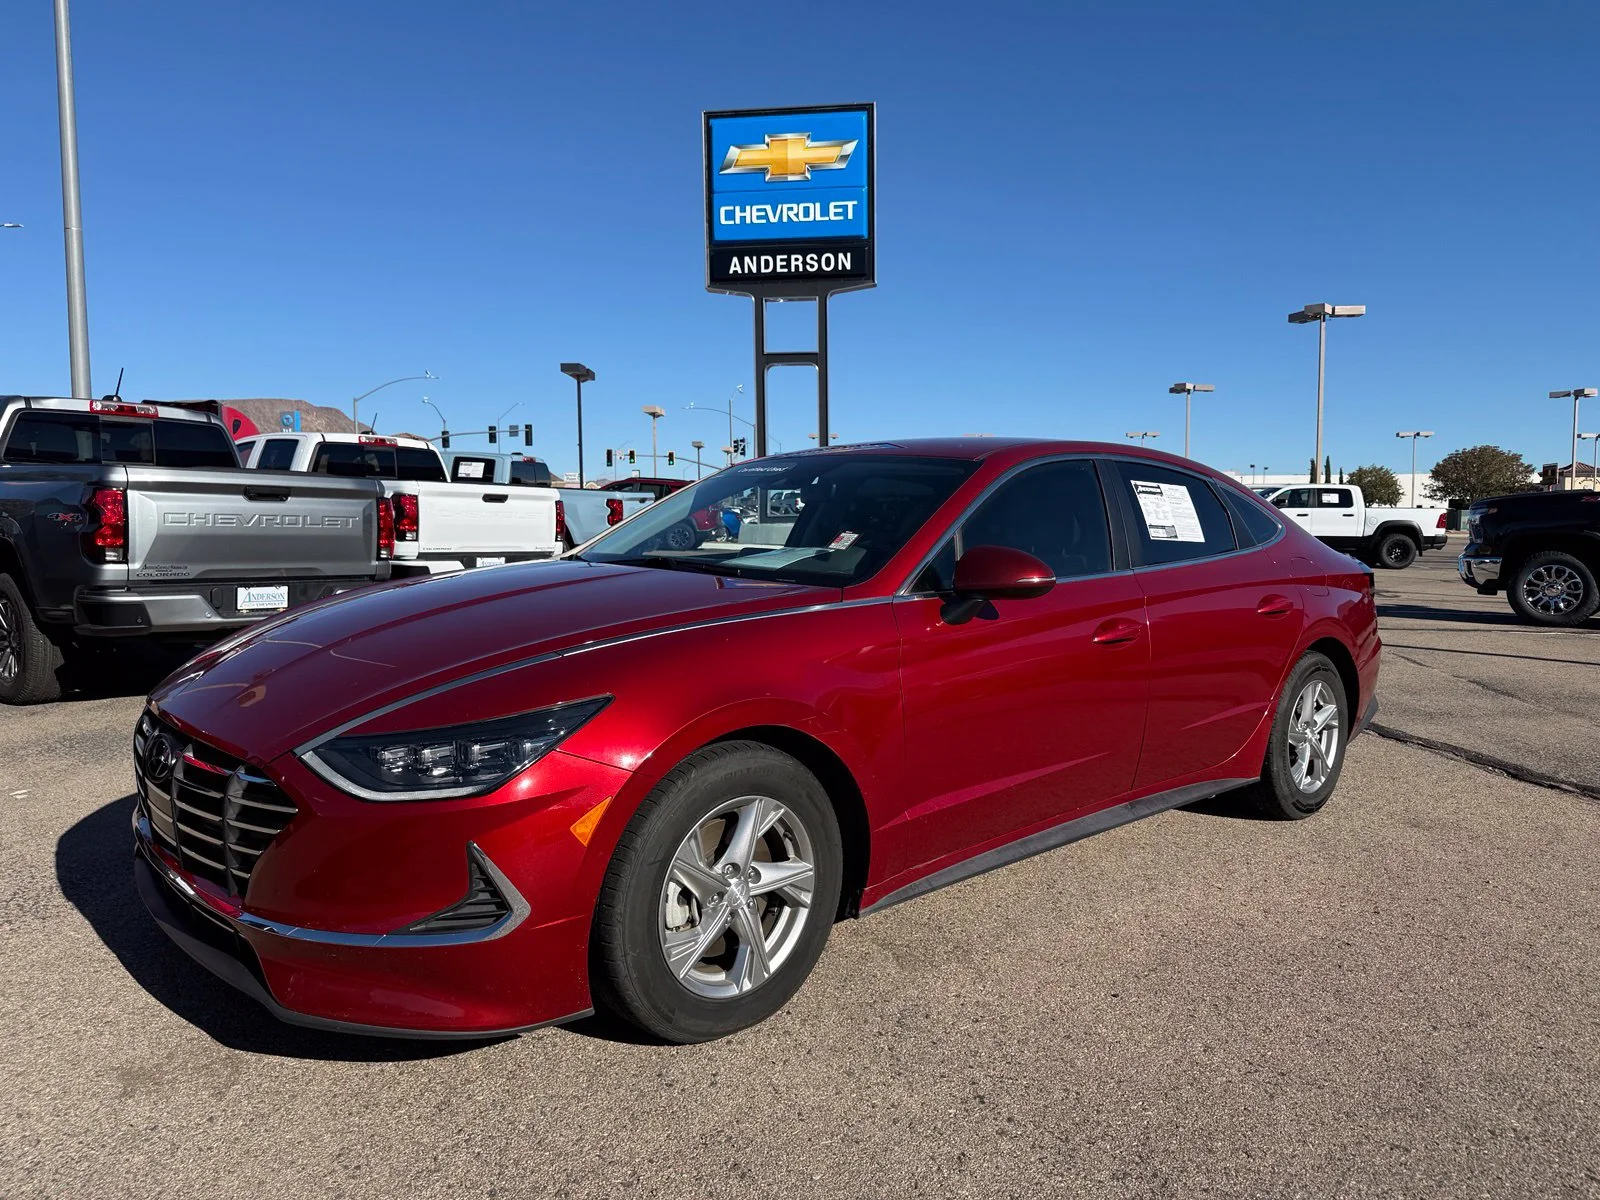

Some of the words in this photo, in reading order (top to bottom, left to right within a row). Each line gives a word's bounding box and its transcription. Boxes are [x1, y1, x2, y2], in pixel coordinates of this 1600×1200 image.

[719, 201, 858, 225] CHEVROLET
[728, 252, 851, 275] ANDERSON
[163, 512, 359, 529] CHEVROLET
